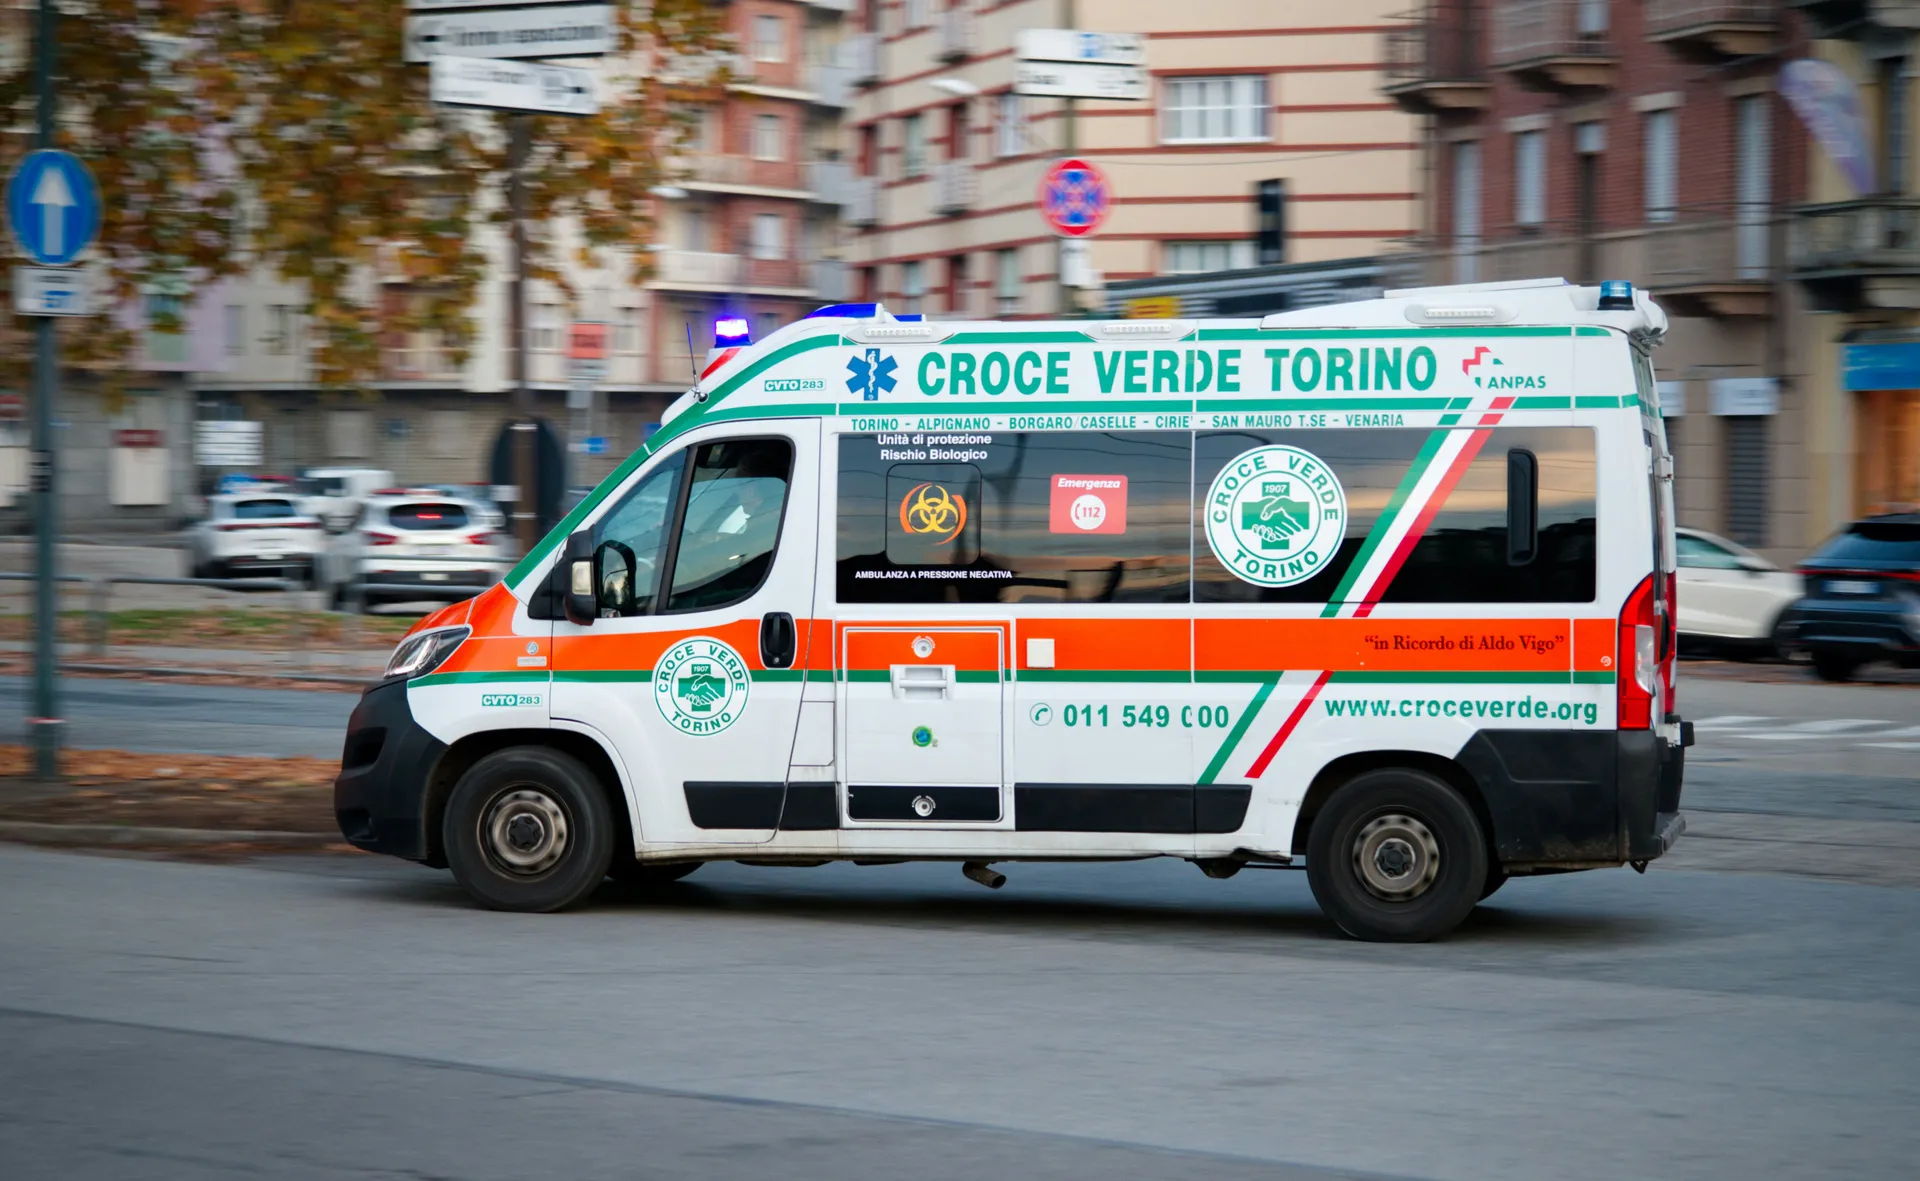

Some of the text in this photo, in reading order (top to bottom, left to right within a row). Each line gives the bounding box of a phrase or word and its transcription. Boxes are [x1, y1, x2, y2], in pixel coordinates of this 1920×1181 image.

[917, 346, 1438, 396] CROCE VERDE TORINO
[765, 380, 824, 391] CVTO 283
[1487, 375, 1547, 389] ANPAS
[851, 419, 899, 431] TORINO
[917, 417, 991, 430] ALPIGNANO
[1212, 415, 1239, 428] SAN
[1245, 415, 1292, 428] MAURO
[1298, 414, 1327, 427] T.SE
[1345, 414, 1404, 427] VENARIA
[877, 433, 992, 447] Unità di protezione
[880, 448, 988, 462] Rischio Biologico
[1057, 477, 1121, 490] Emergenza
[1213, 455, 1338, 523] CROCE VERDE
[1264, 484, 1287, 493] 1907
[1082, 506, 1101, 518] 112
[1233, 549, 1319, 578] TORINO
[855, 571, 1013, 579] AMBULANZA A PRESSIONE NEGATIVA
[1393, 635, 1455, 650] Ricordo
[1459, 635, 1474, 650] di
[1478, 635, 1515, 650] Aldo
[658, 645, 745, 693] CROCE VERDE
[483, 695, 540, 705] CVTO 283
[1063, 704, 1108, 727] 011
[1122, 704, 1170, 728] 549
[1324, 695, 1598, 724] www.croceverde.org
[672, 711, 731, 732] TORINO
